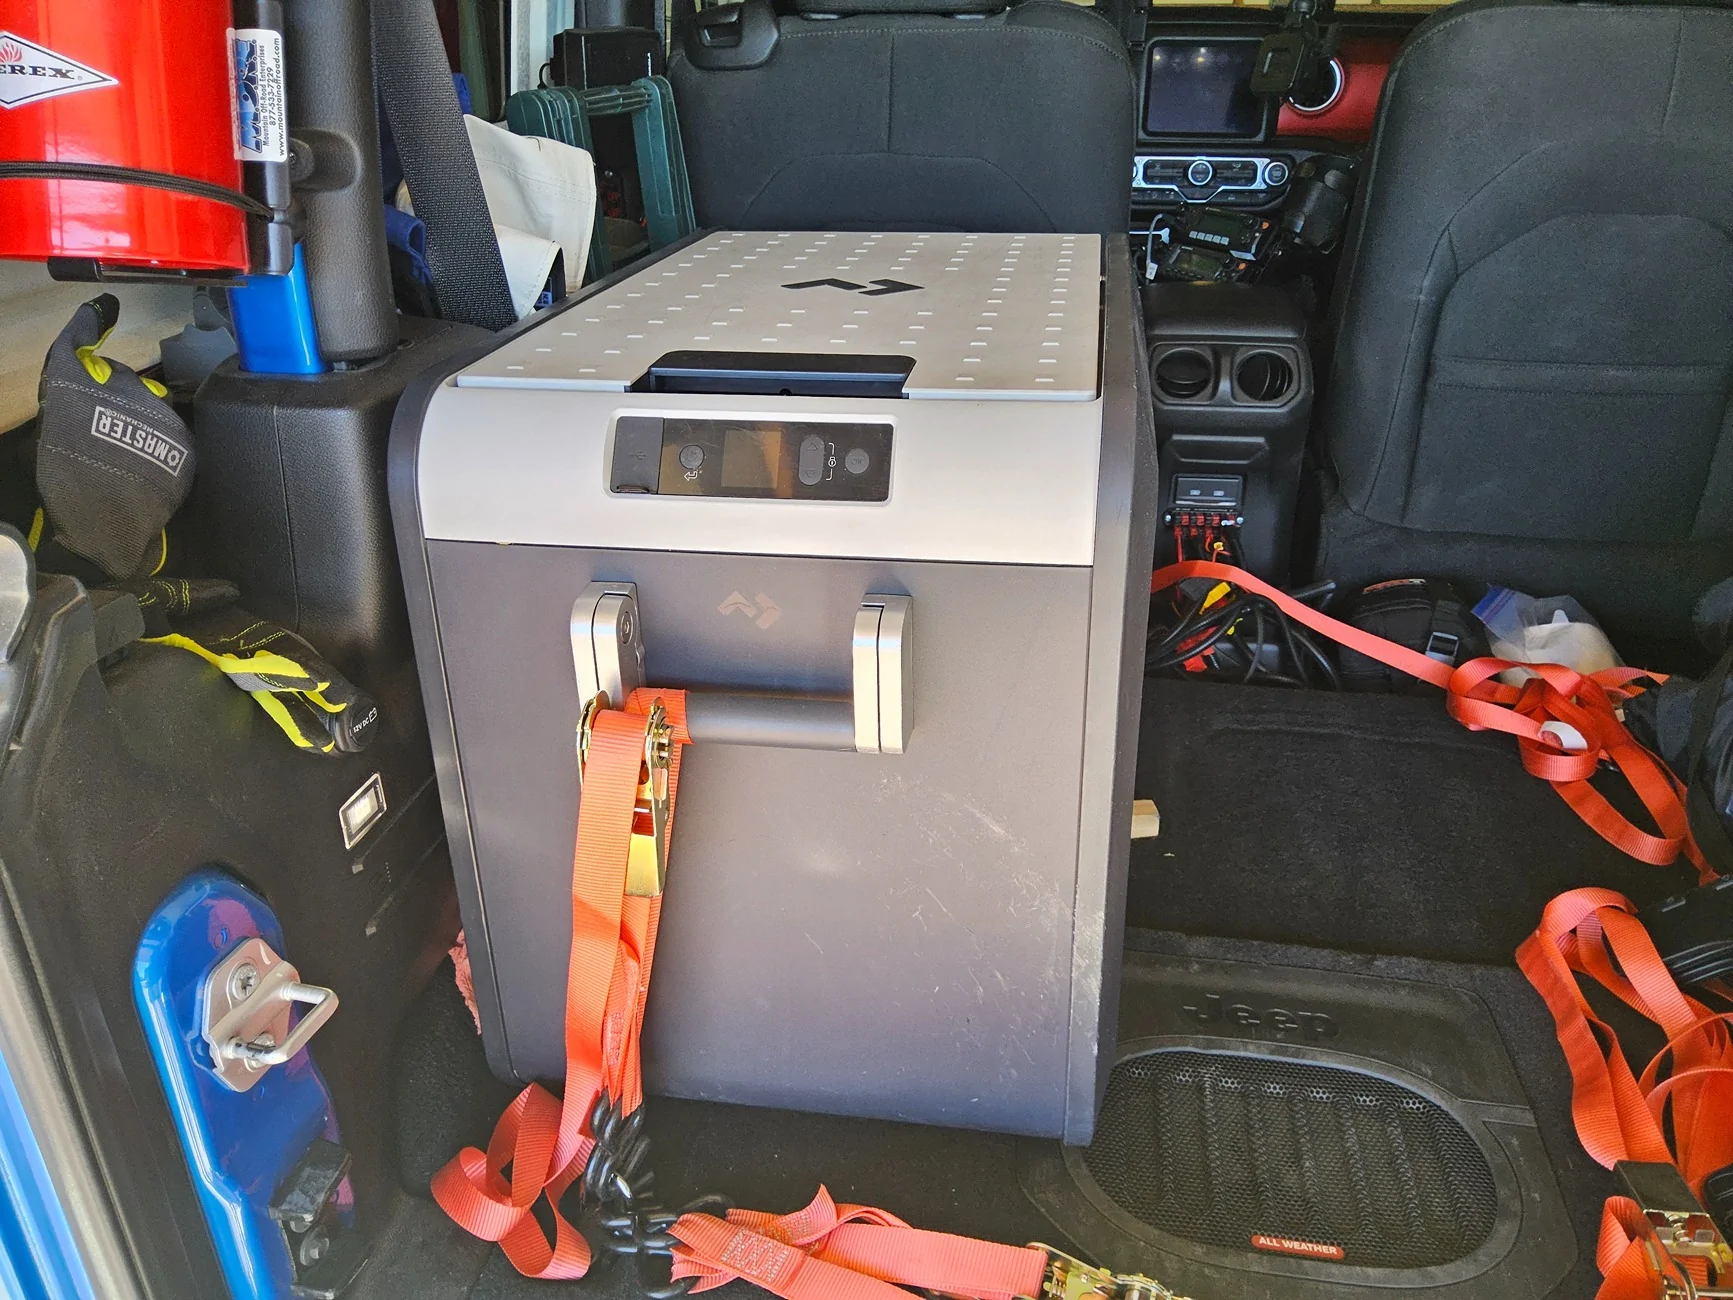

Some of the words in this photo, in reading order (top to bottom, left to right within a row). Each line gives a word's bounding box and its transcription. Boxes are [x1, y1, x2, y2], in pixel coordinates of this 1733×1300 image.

[259, 44, 267, 82] Enterprises
[260, 82, 268, 113] Off-Road
[267, 66, 277, 126] 877-533-7229
[273, 37, 285, 157] www.mountainoffroad.com
[262, 115, 270, 147] Mountain
[99, 414, 170, 462] MASTER
[353, 722, 363, 733] 12V
[362, 717, 370, 728] DC
[1180, 993, 1339, 1041] Jeep
[1258, 1236, 1281, 1247] ALL
[1281, 1239, 1338, 1255] WEATHER
